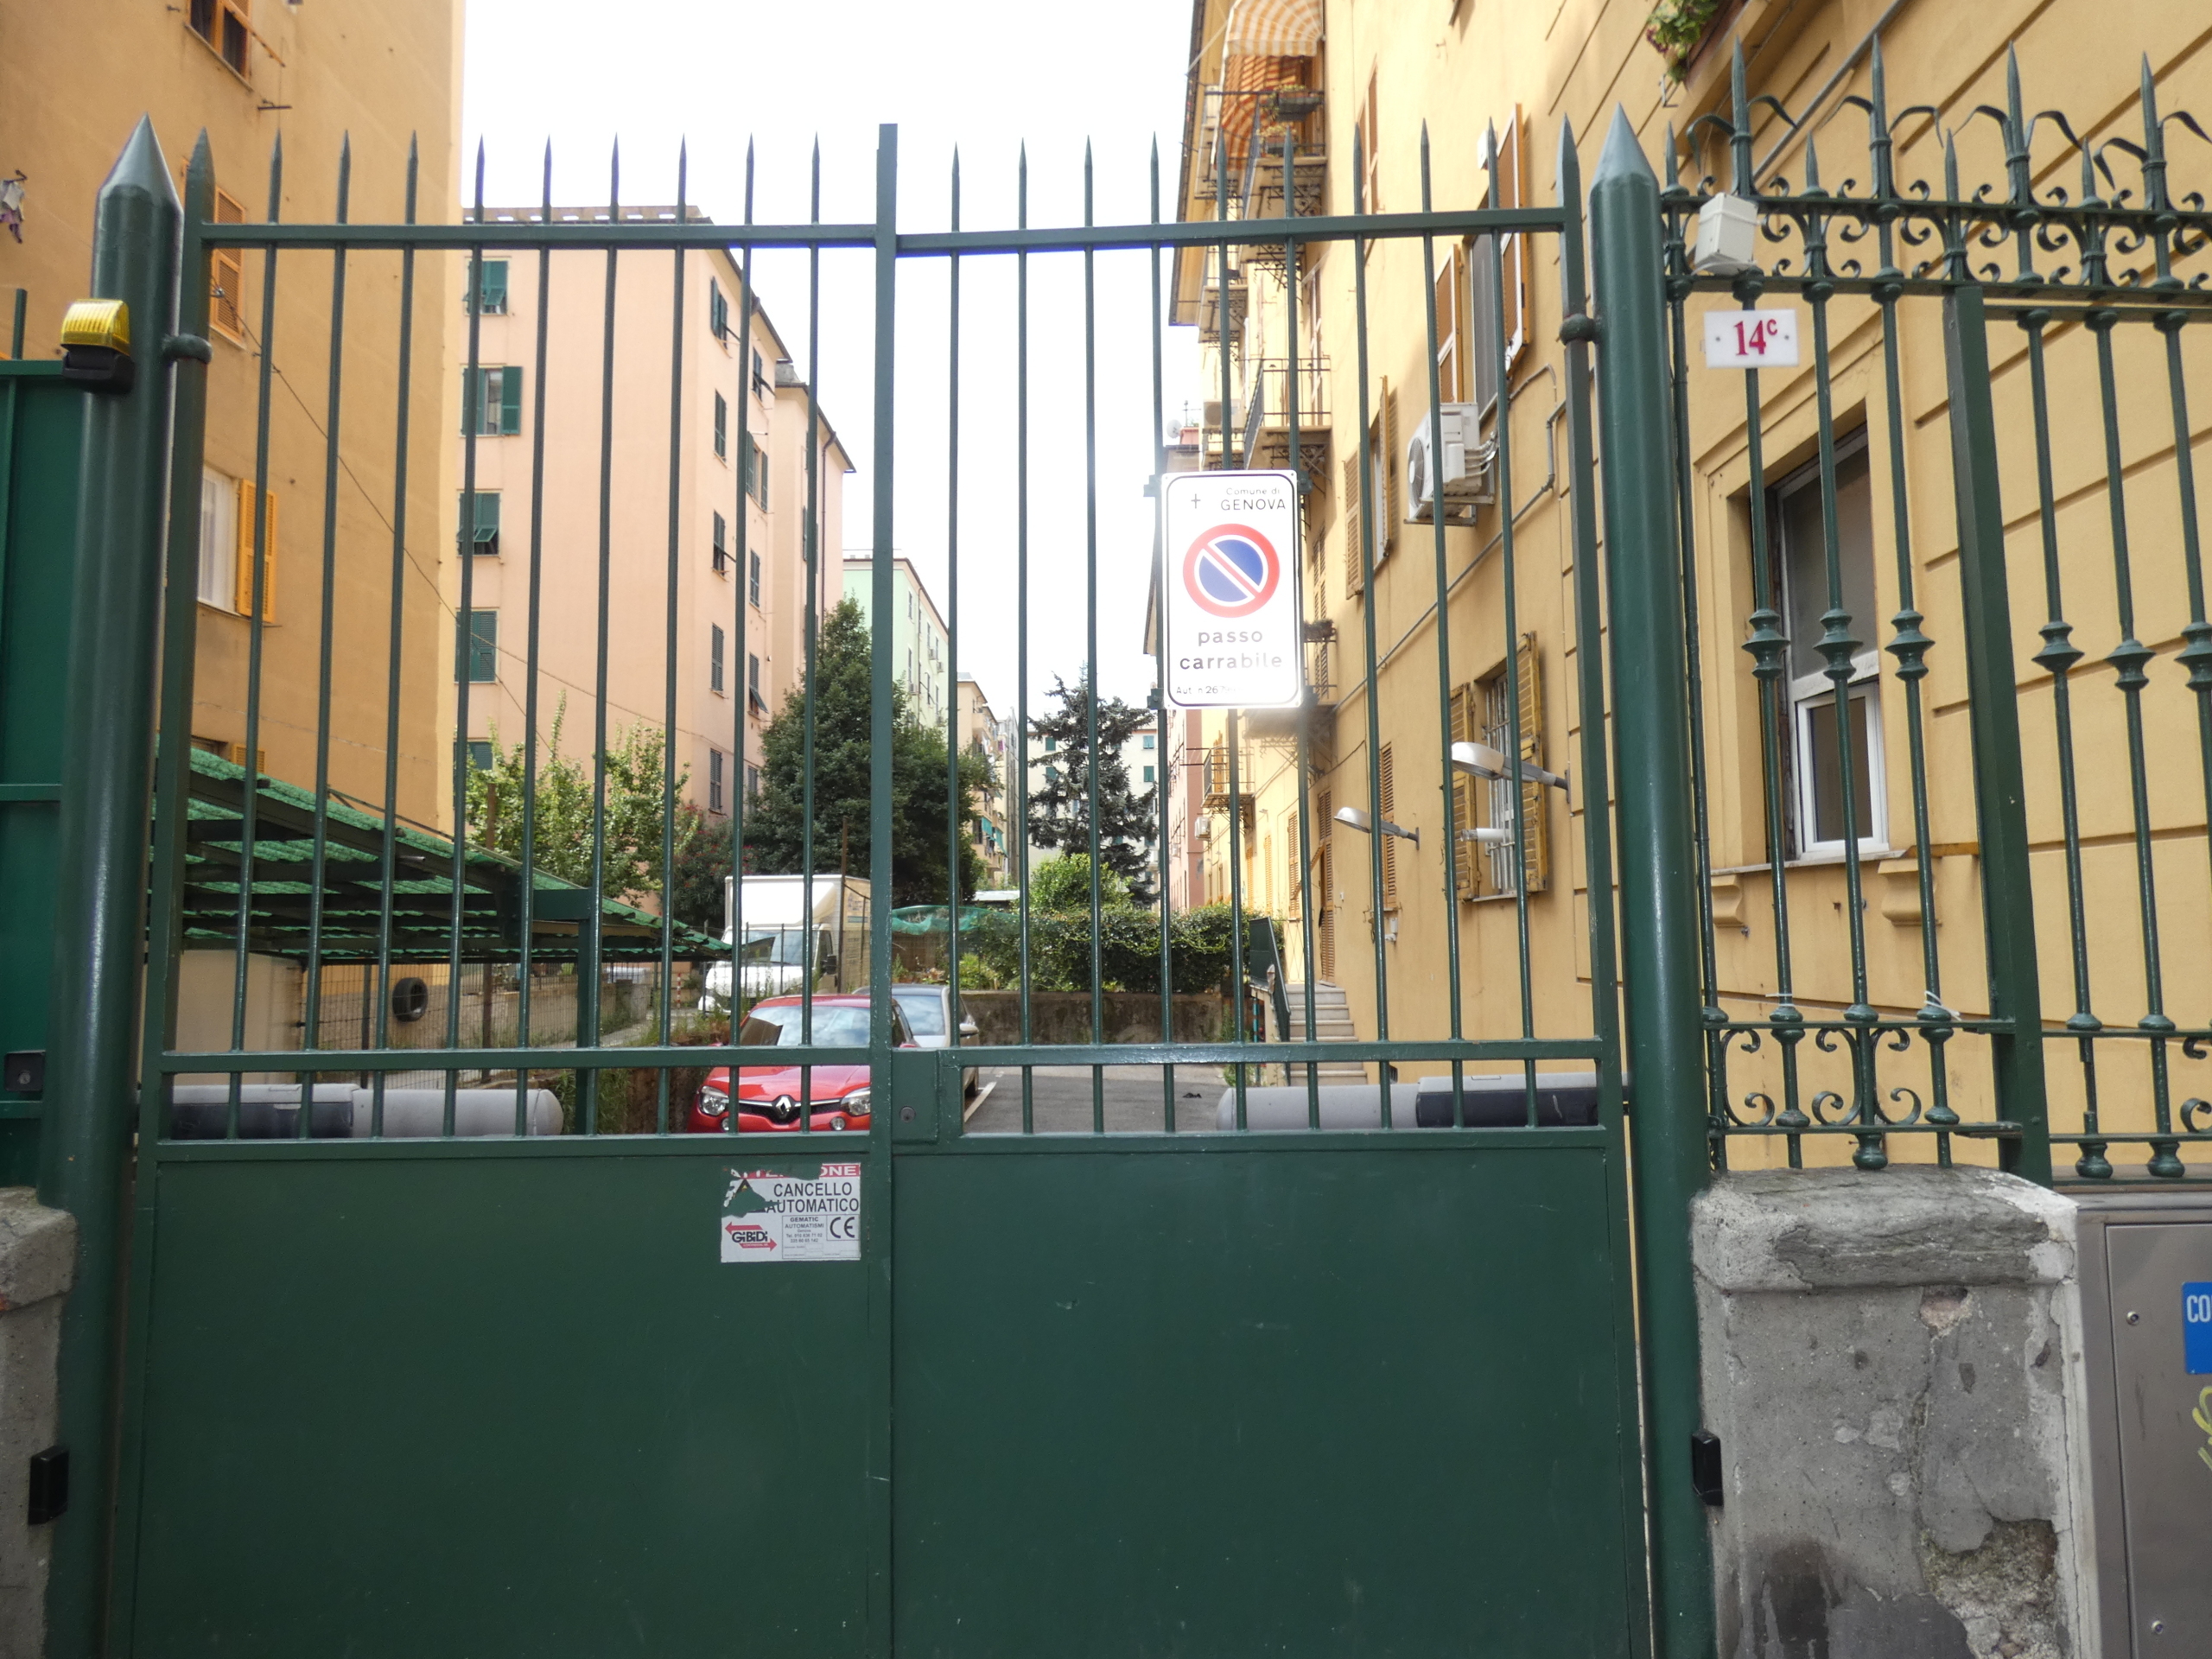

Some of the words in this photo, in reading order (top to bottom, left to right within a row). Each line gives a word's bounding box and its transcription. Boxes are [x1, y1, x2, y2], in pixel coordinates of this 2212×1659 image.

[1226, 487, 1268, 496] Comune
[1221, 498, 1286, 512] GENOVA
[1198, 630, 1263, 647] passo
[1179, 652, 1282, 670] carrabile
[773, 1181, 852, 1198] CANCELLO
[766, 1198, 859, 1213] AUTOMATICO
